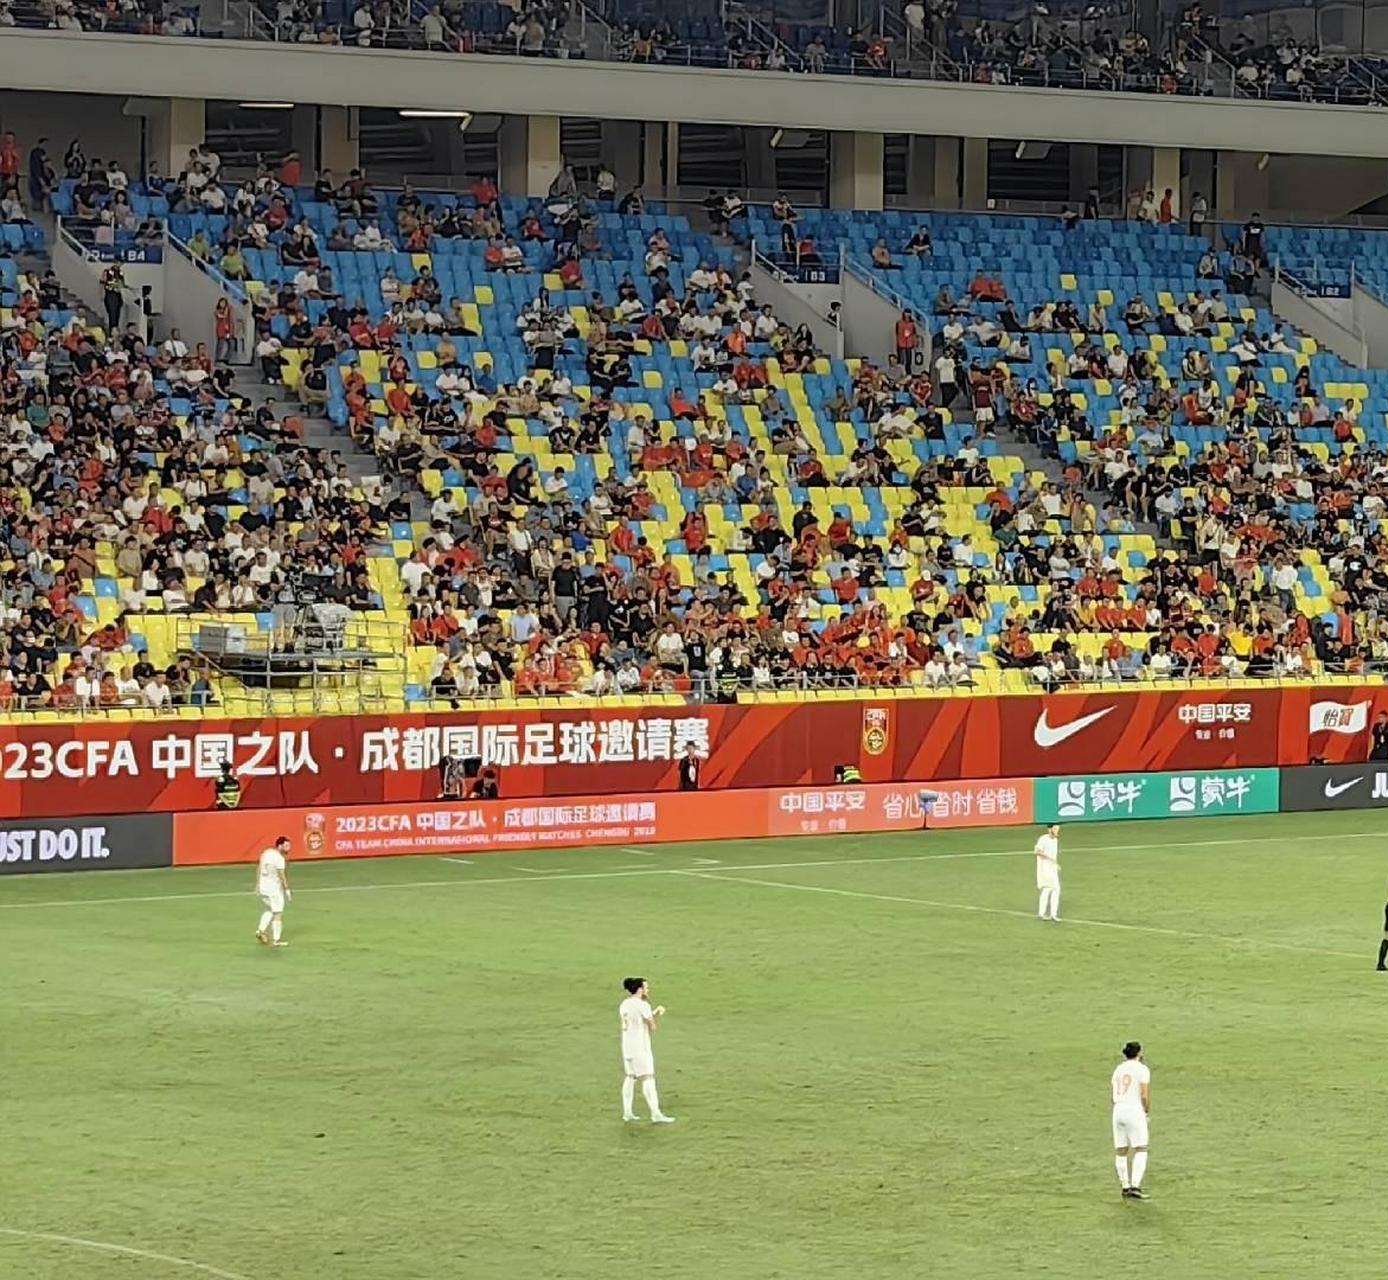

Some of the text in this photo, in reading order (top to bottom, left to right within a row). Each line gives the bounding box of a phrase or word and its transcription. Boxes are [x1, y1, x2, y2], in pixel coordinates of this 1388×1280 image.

[1177, 703, 1251, 724] 中国平安
[0, 739, 140, 779] 23CFA
[779, 791, 866, 813] 中国平安
[1090, 781, 1144, 813] 蒙牛
[1199, 776, 1253, 808] 蒙牛
[336, 814, 412, 833] 2023CFA
[39, 829, 78, 861] DO
[81, 827, 110, 858] IT.
[1116, 1074, 1132, 1096] 19
